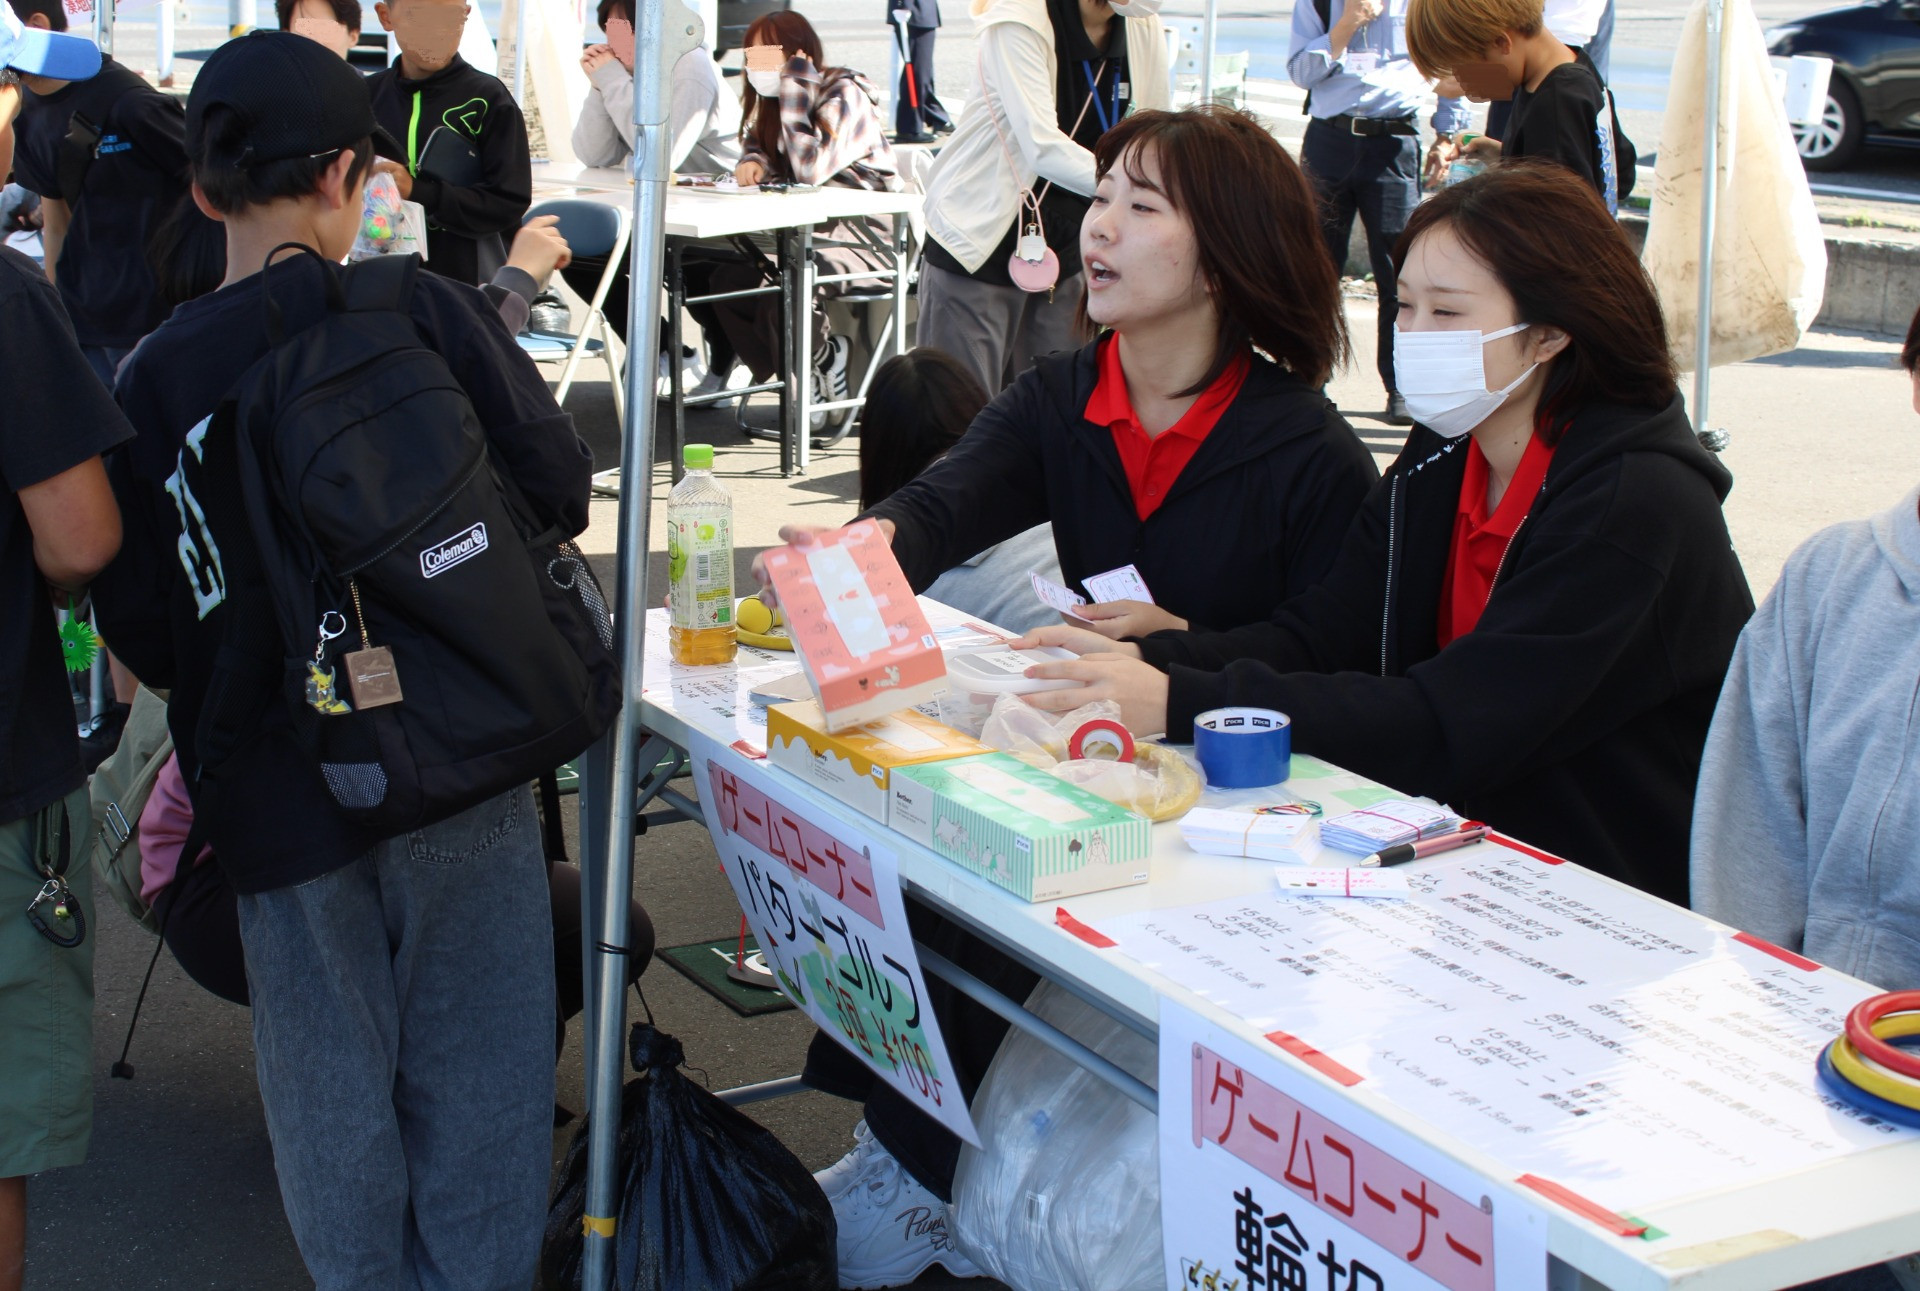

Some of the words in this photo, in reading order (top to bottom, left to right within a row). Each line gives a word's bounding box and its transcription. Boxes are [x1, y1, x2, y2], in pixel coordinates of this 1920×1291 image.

[425, 537, 474, 569] Coleman
[721, 770, 872, 901] ゲームコーナー
[1414, 872, 1442, 885] 大人
[1499, 859, 1550, 879] ルール
[738, 855, 920, 1029] パターゴルフ
[1359, 896, 1481, 955] 点数を出してください。
[1763, 969, 1823, 994] ルール
[825, 977, 874, 1058] 3回
[1210, 1061, 1482, 1266] ゲームコーナー
